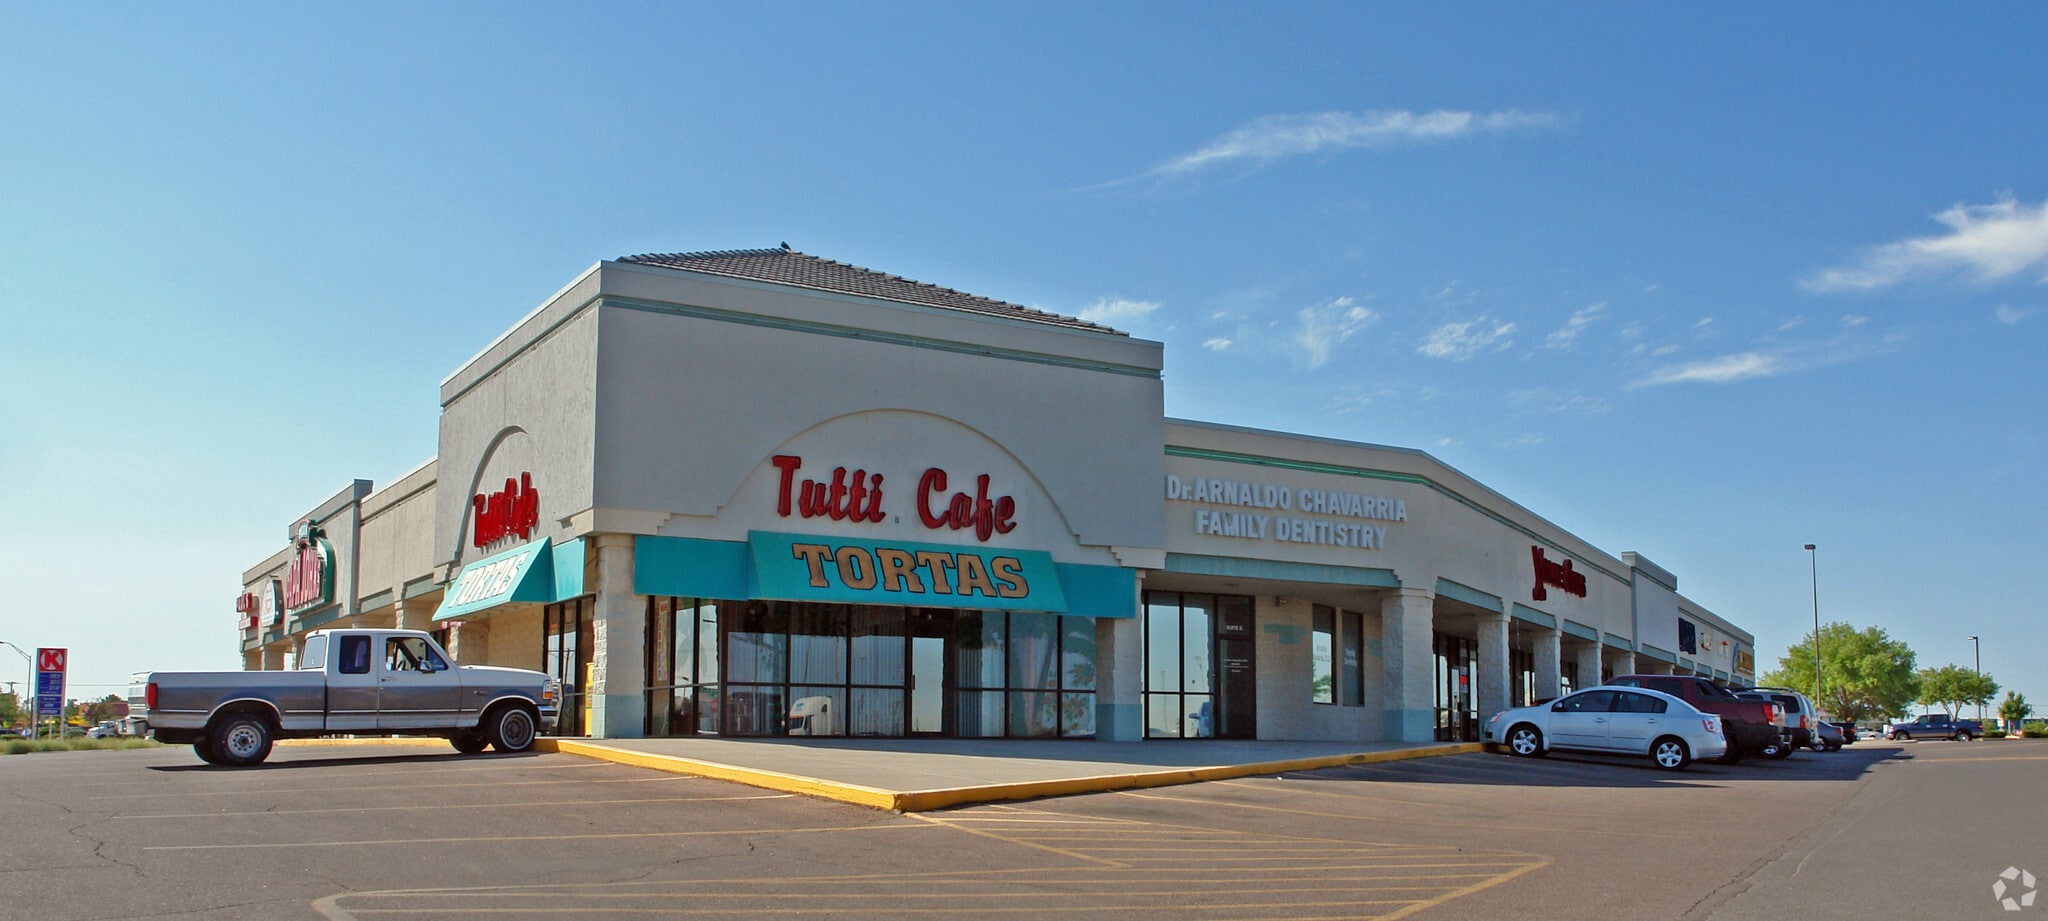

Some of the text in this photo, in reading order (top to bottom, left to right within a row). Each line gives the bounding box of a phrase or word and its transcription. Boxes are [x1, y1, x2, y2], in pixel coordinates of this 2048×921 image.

[772, 455, 1017, 542] Tutti Cafe
[1298, 487, 1409, 522] CHAVARRIA
[1195, 509, 1387, 549] FAMILY DENTISTRY
[448, 551, 531, 608] TORTAS
[792, 543, 1030, 599] TORTAS
